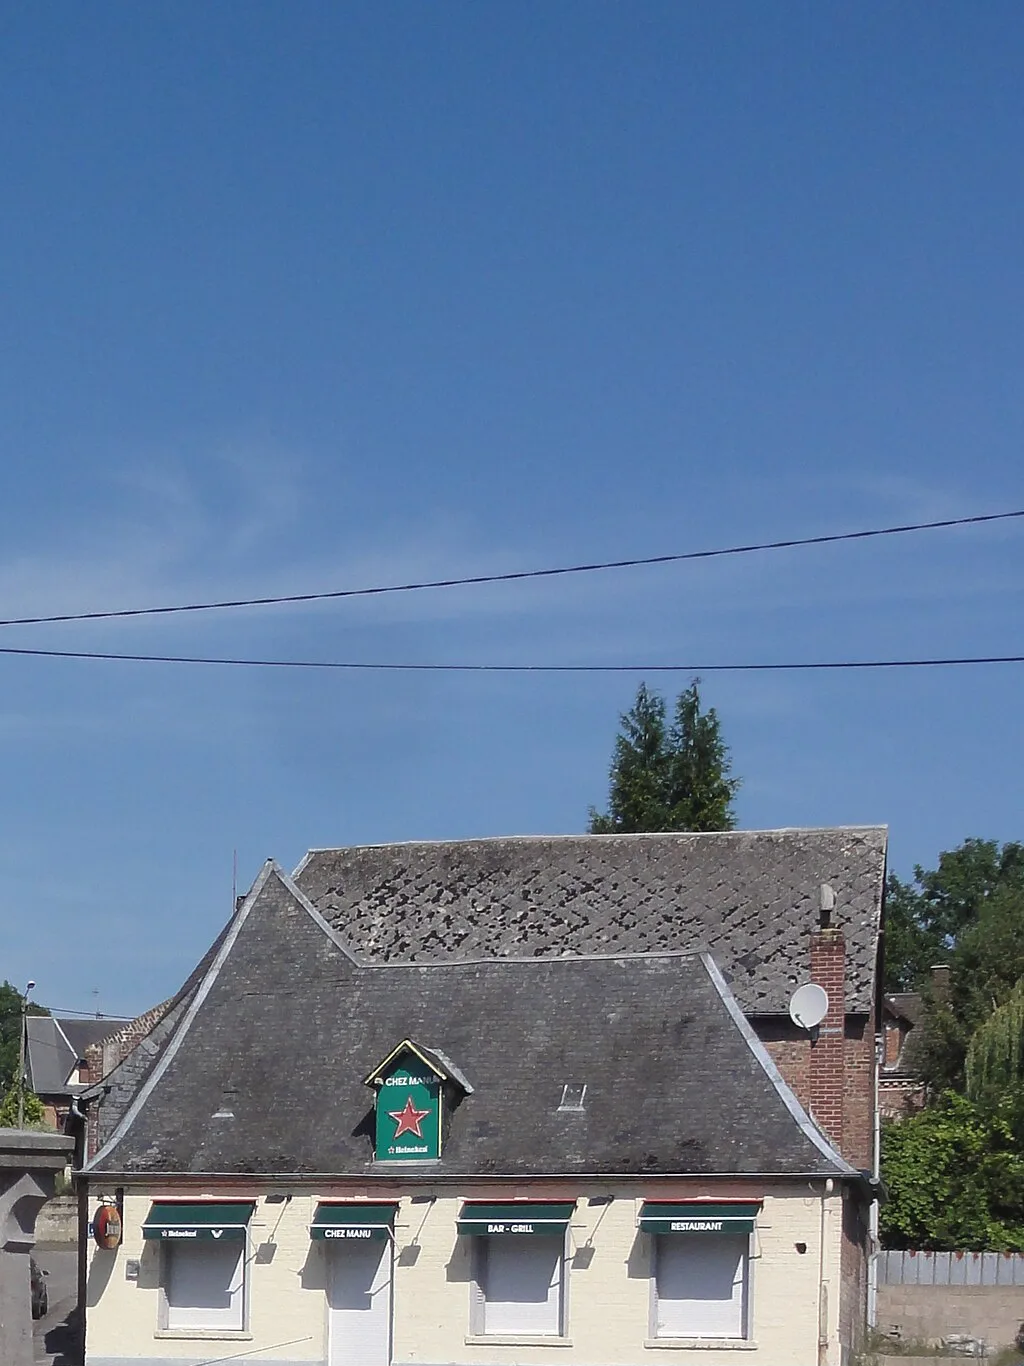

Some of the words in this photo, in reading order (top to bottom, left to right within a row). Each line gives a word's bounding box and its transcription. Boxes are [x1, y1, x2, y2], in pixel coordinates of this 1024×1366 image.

[385, 1077, 407, 1086] CHEZ
[487, 1224, 504, 1233] BAR
[511, 1224, 534, 1233] GRILL
[671, 1222, 723, 1231] RESTAURANT
[324, 1229, 345, 1238] CHEZ
[346, 1229, 371, 1238] MANU
